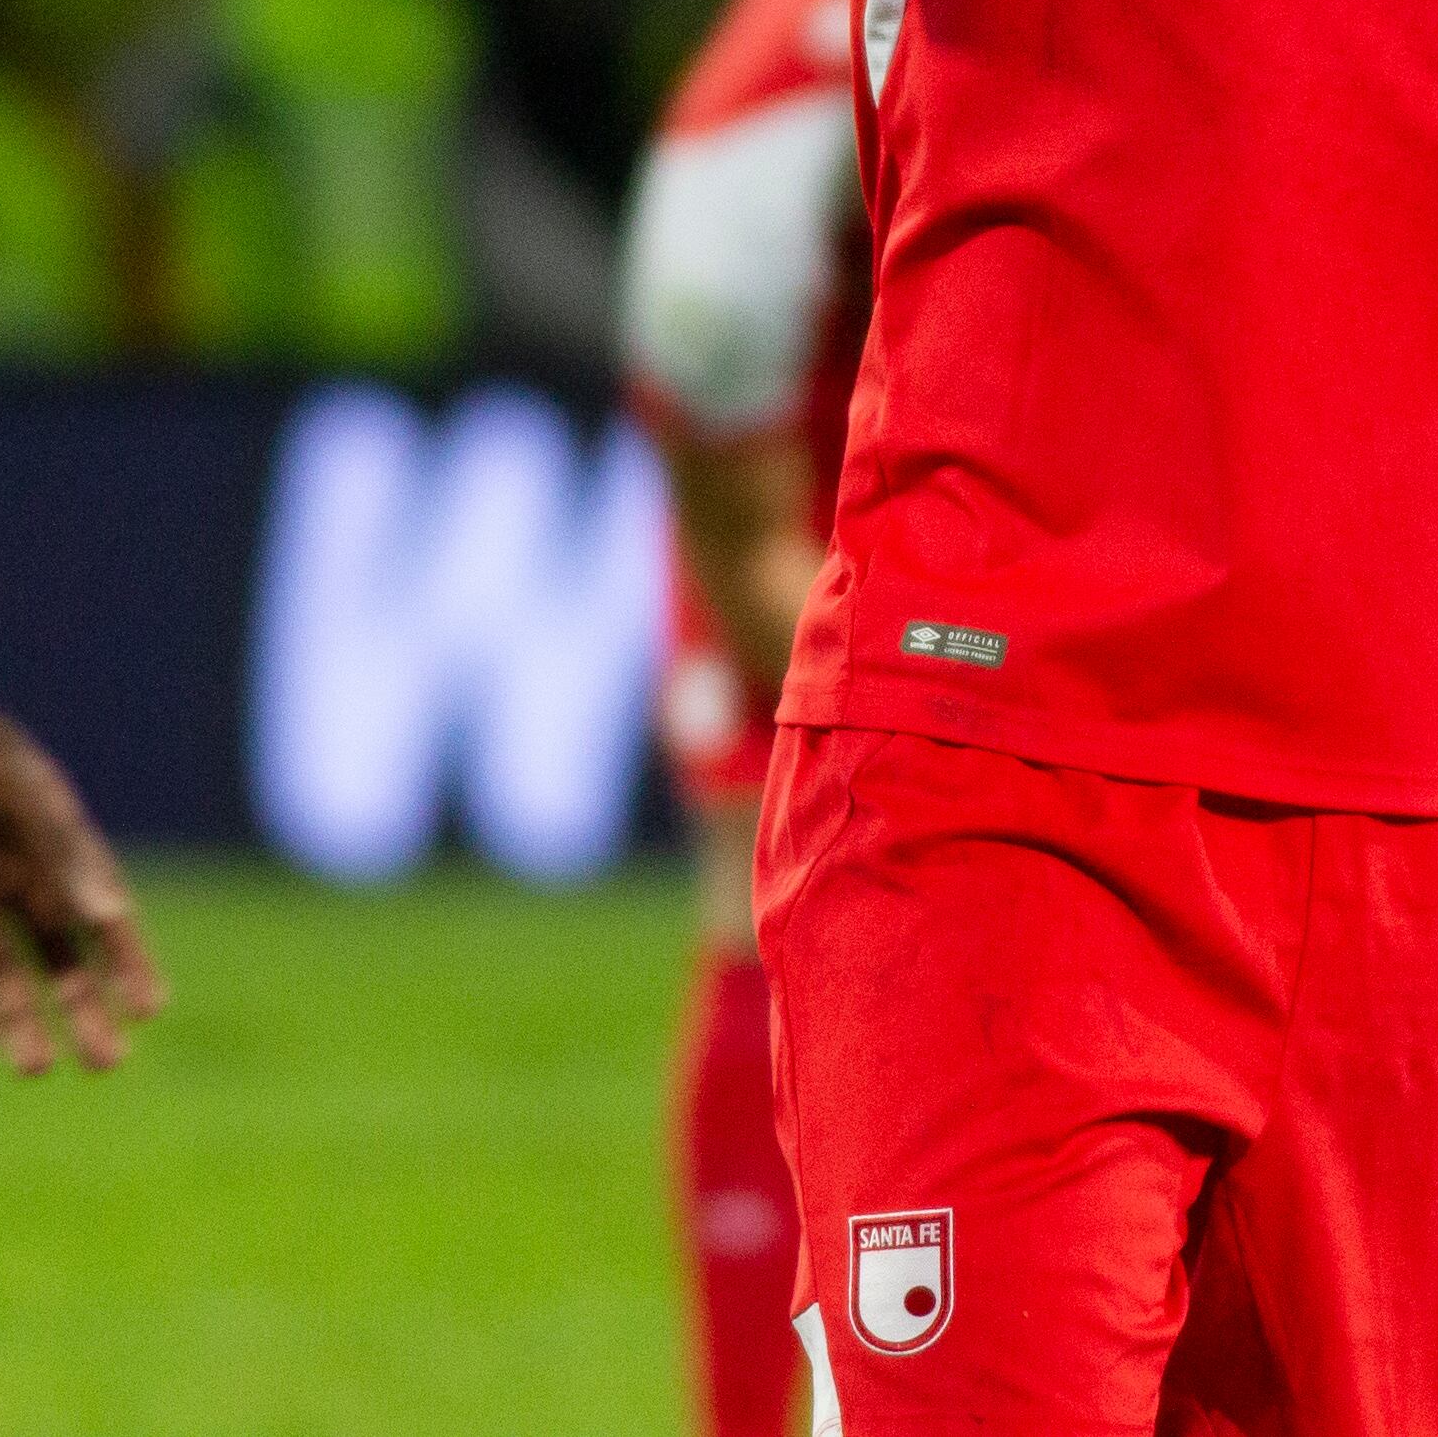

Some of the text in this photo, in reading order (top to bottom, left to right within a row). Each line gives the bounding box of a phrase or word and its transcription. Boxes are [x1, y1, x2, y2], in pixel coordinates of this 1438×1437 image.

[948, 631, 1000, 649] OFFICIAL
[859, 1222, 941, 1249] SANTA FE
